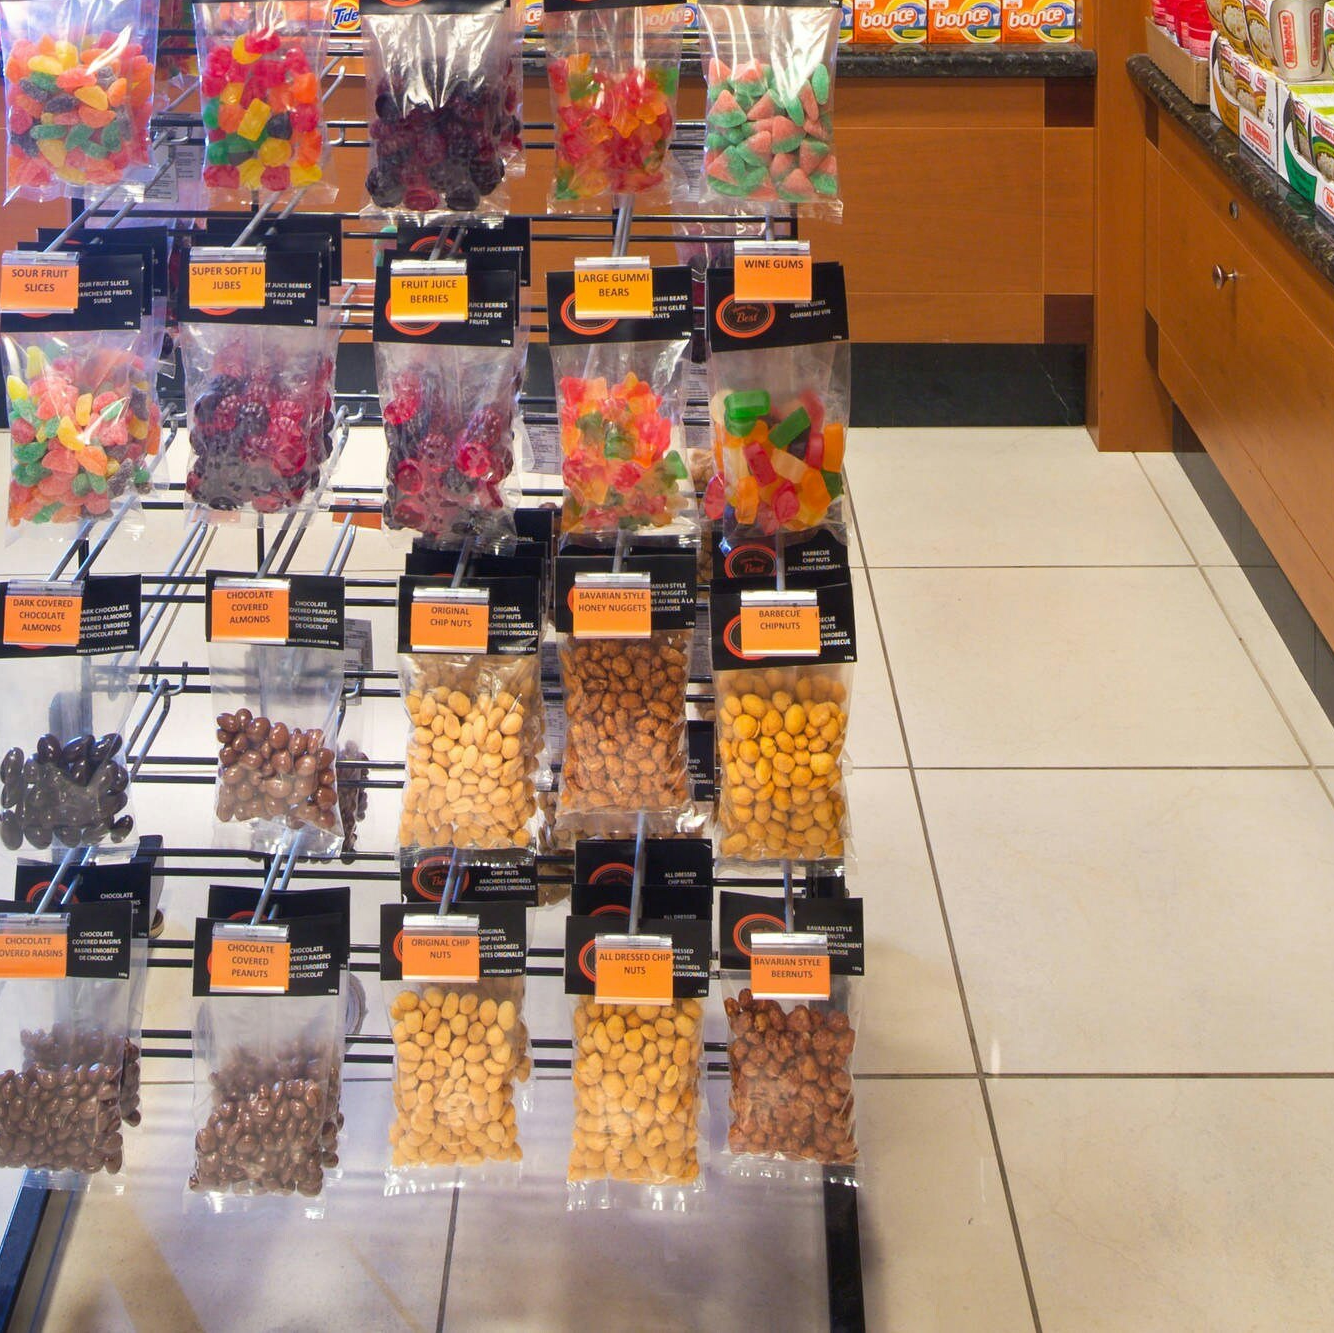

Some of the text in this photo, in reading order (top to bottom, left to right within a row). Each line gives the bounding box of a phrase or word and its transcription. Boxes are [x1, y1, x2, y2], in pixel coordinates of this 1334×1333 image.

[860, 8, 917, 28] bounce
[935, 8, 991, 28] bounce
[744, 260, 803, 269] WINE GUMS
[12, 269, 68, 278] SOUR FRUIT
[192, 267, 261, 275] SUPER SOFT JU
[579, 274, 649, 282] LARGE GUMMI
[25, 284, 54, 292] SLICES
[213, 281, 241, 289] JUBES
[402, 280, 456, 289] FRUIT JUICE
[599, 288, 629, 296] BEARS
[411, 295, 448, 303] BERRIES
[227, 591, 273, 599] CHOCOLATE
[13, 599, 73, 607] DARK COVERED
[232, 603, 268, 611] COVERED
[431, 607, 469, 615] ORIGINAL
[579, 604, 646, 612] HONEY NUGGETS
[19, 611, 65, 619] CHOCOLATE
[230, 616, 270, 624] ALMONDS
[451, 619, 472, 627] NUTS
[22, 624, 61, 632] ALMONDS
[5, 937, 51, 945] CHOCOLATE
[32, 949, 63, 957] RAISINS
[228, 944, 274, 954] CHOCOLATE
[232, 956, 269, 965] COVERED
[599, 953, 613, 961] ALL
[615, 953, 650, 961] DRESSED
[754, 957, 796, 965] BAVARIAN
[232, 969, 267, 977] PEANUTS
[624, 966, 646, 974] NUTS
[772, 970, 813, 978] BEERNUTS
